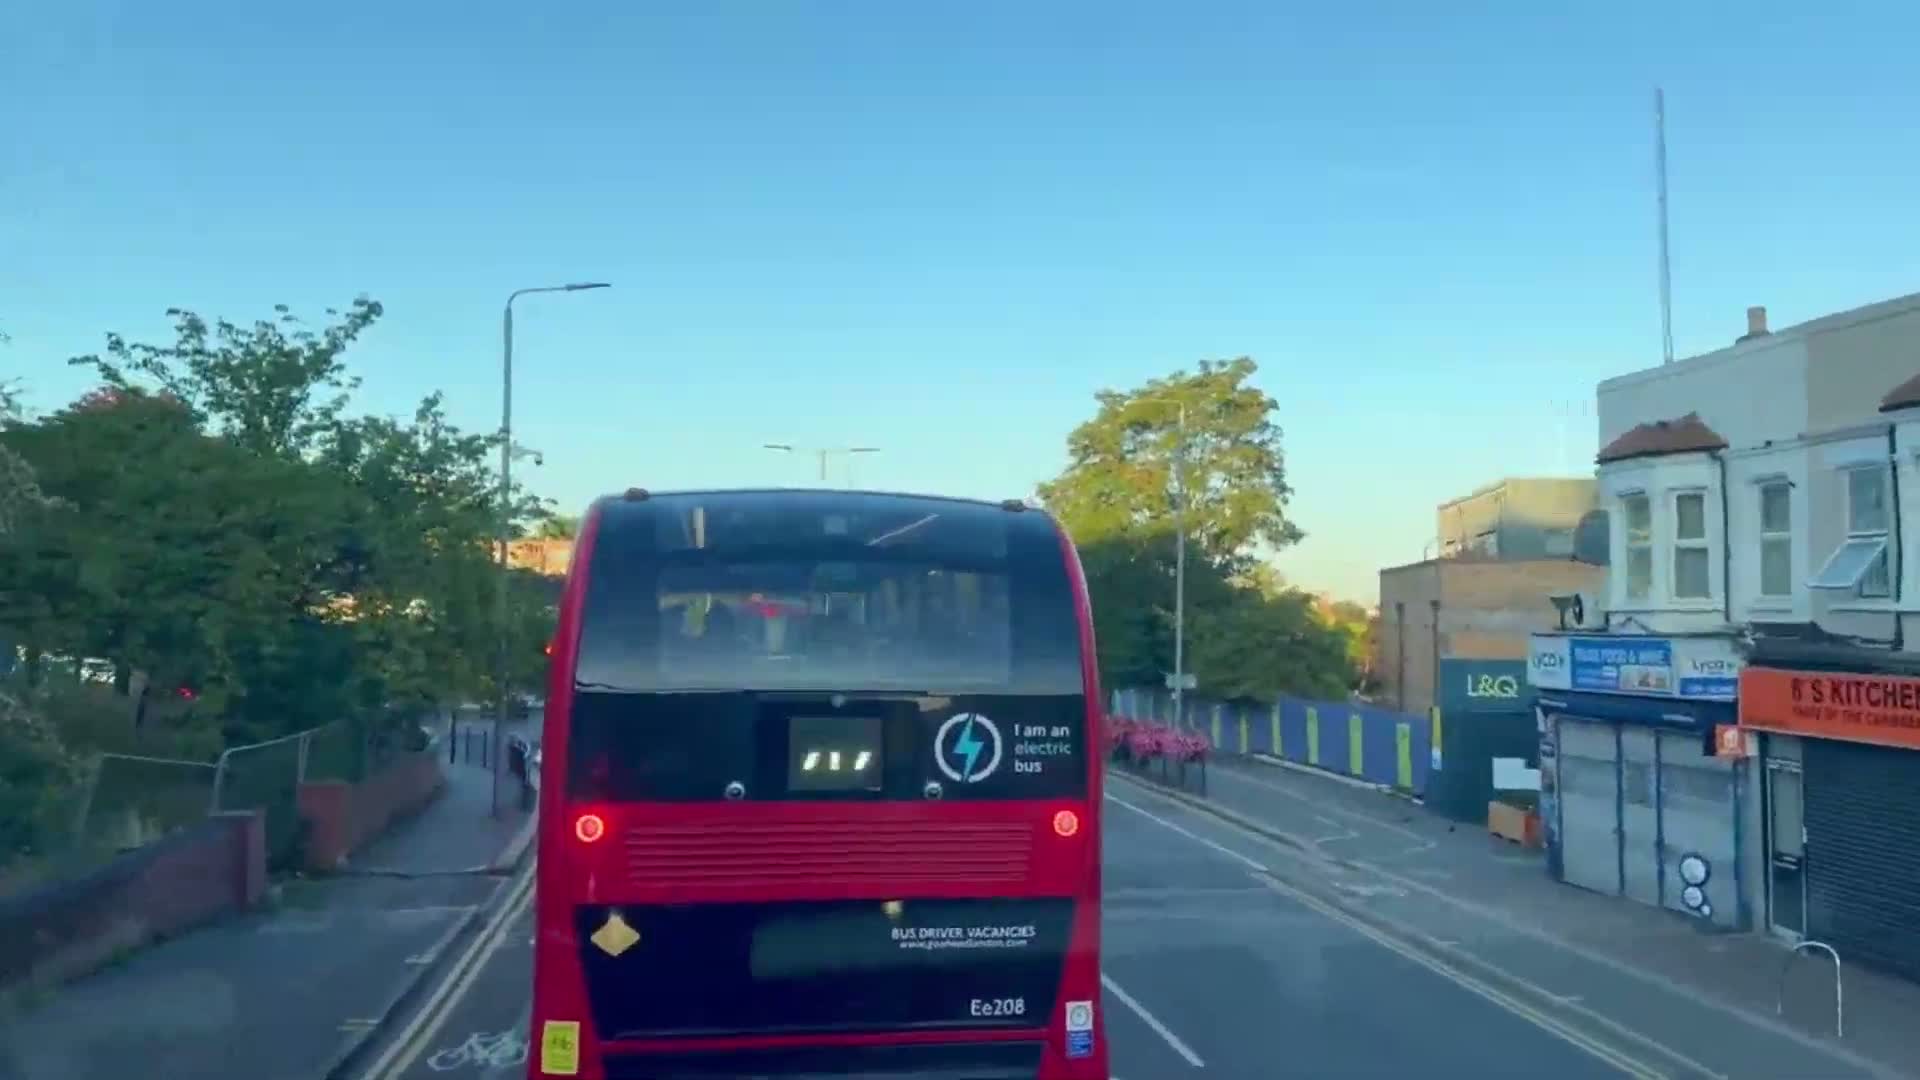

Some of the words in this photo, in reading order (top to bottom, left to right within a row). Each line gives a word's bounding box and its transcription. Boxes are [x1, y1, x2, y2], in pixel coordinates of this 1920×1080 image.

[1467, 673, 1519, 698] L&Q
[1023, 726, 1046, 737] am
[1050, 726, 1070, 737] an
[1014, 740, 1071, 755] electric
[1014, 759, 1042, 773] bus
[891, 927, 916, 940] BUS
[918, 927, 963, 939] DRIVER
[967, 925, 1036, 938] VACANCIES
[970, 998, 1025, 1017] Ee208
